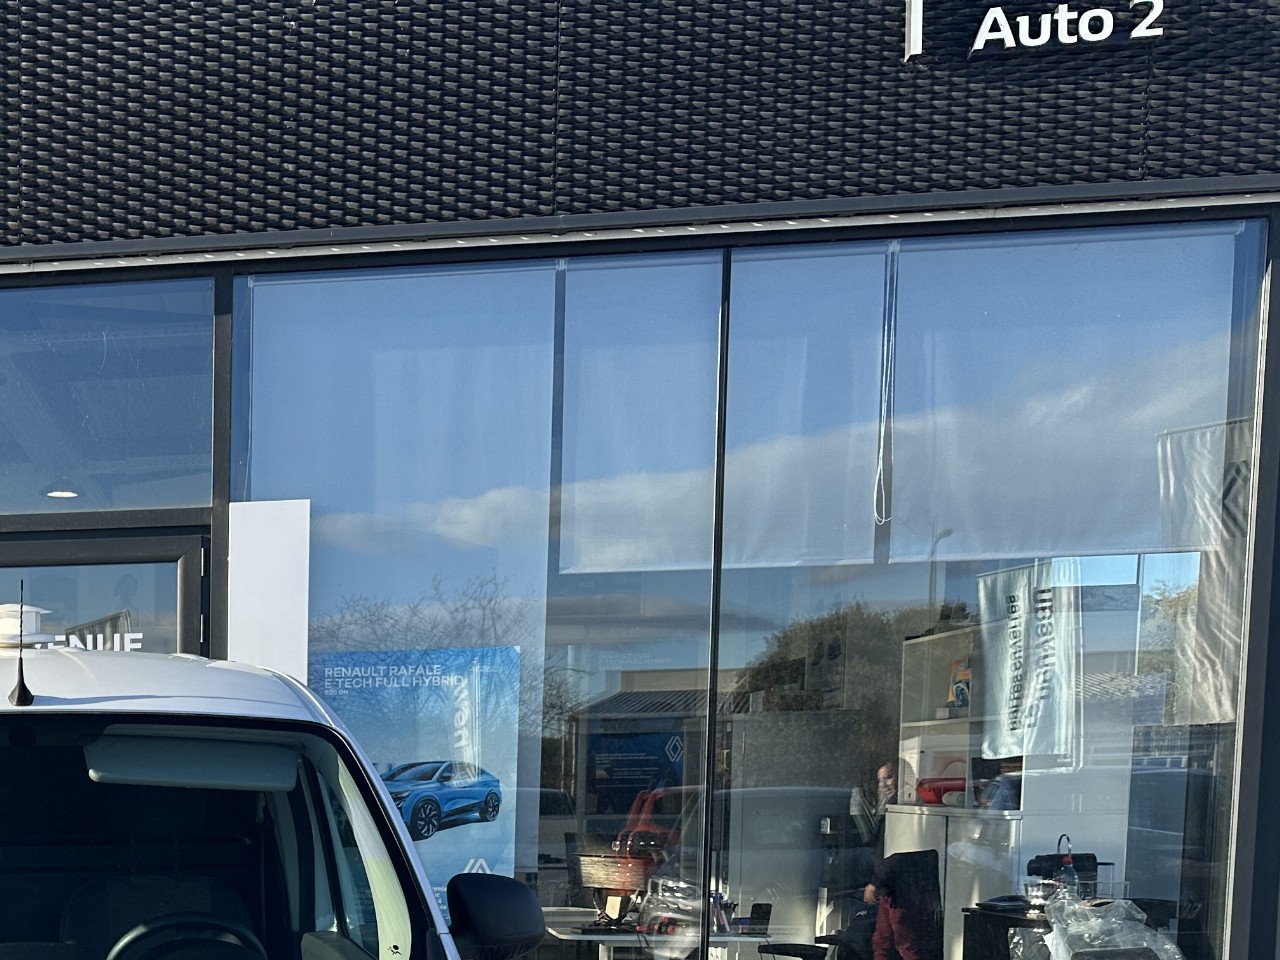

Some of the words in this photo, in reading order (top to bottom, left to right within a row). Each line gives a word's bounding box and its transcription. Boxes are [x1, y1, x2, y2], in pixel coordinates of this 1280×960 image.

[971, 3, 1115, 52] Auto
[1130, 0, 1165, 38] 2
[324, 666, 386, 677] RENAULT
[389, 665, 441, 676] RAFALE
[324, 677, 372, 688] E-TECH
[375, 677, 410, 687] FULL
[412, 676, 463, 687] HYBRID
